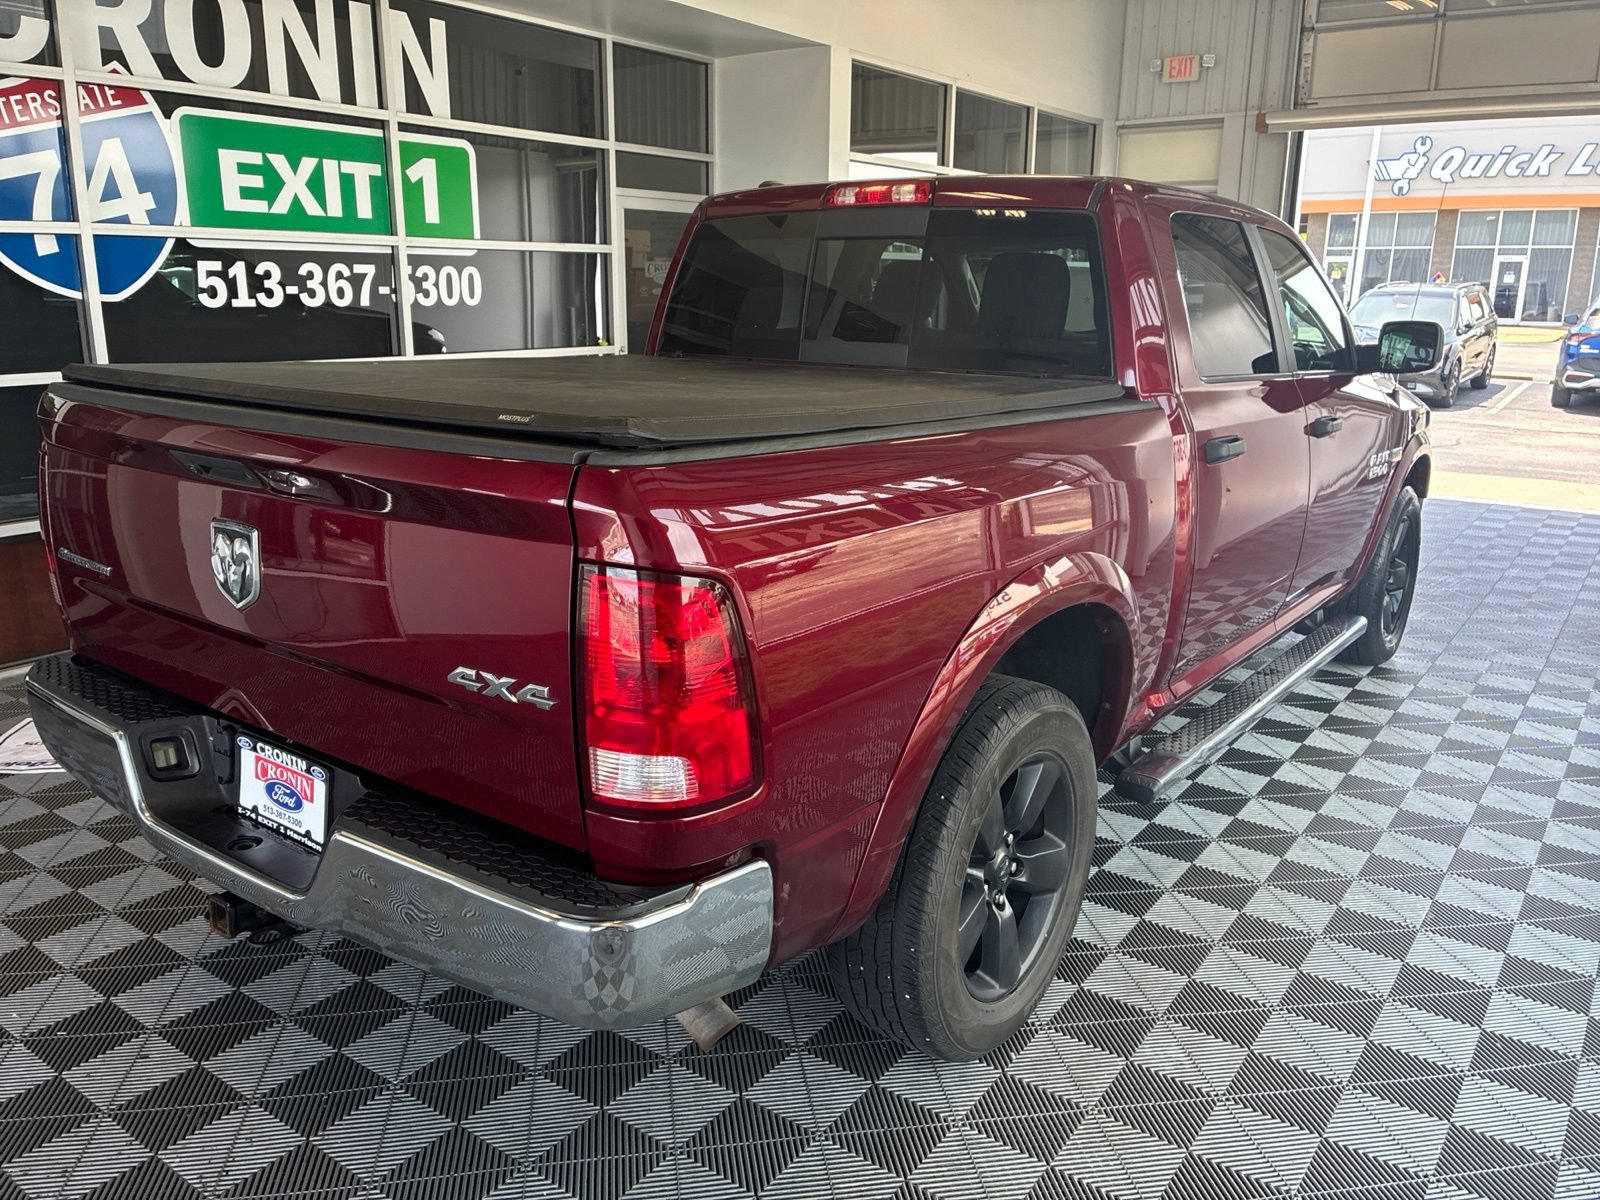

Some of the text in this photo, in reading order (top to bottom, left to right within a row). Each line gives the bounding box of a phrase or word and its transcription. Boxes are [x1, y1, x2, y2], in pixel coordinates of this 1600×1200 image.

[1168, 55, 1196, 79] EXIT
[0, 85, 122, 124] TERSATE
[1430, 142, 1600, 183] Quick L
[0, 138, 156, 257] 74
[217, 148, 441, 224] EXIT 1
[256, 743, 307, 772] CRONIN
[257, 760, 312, 801] CRONIN
[271, 784, 296, 808] Ford
[237, 806, 257, 820] I-74
[257, 815, 278, 829] EXIT
[286, 829, 322, 852] Harrison
[263, 804, 302, 829] 513-367-5300
